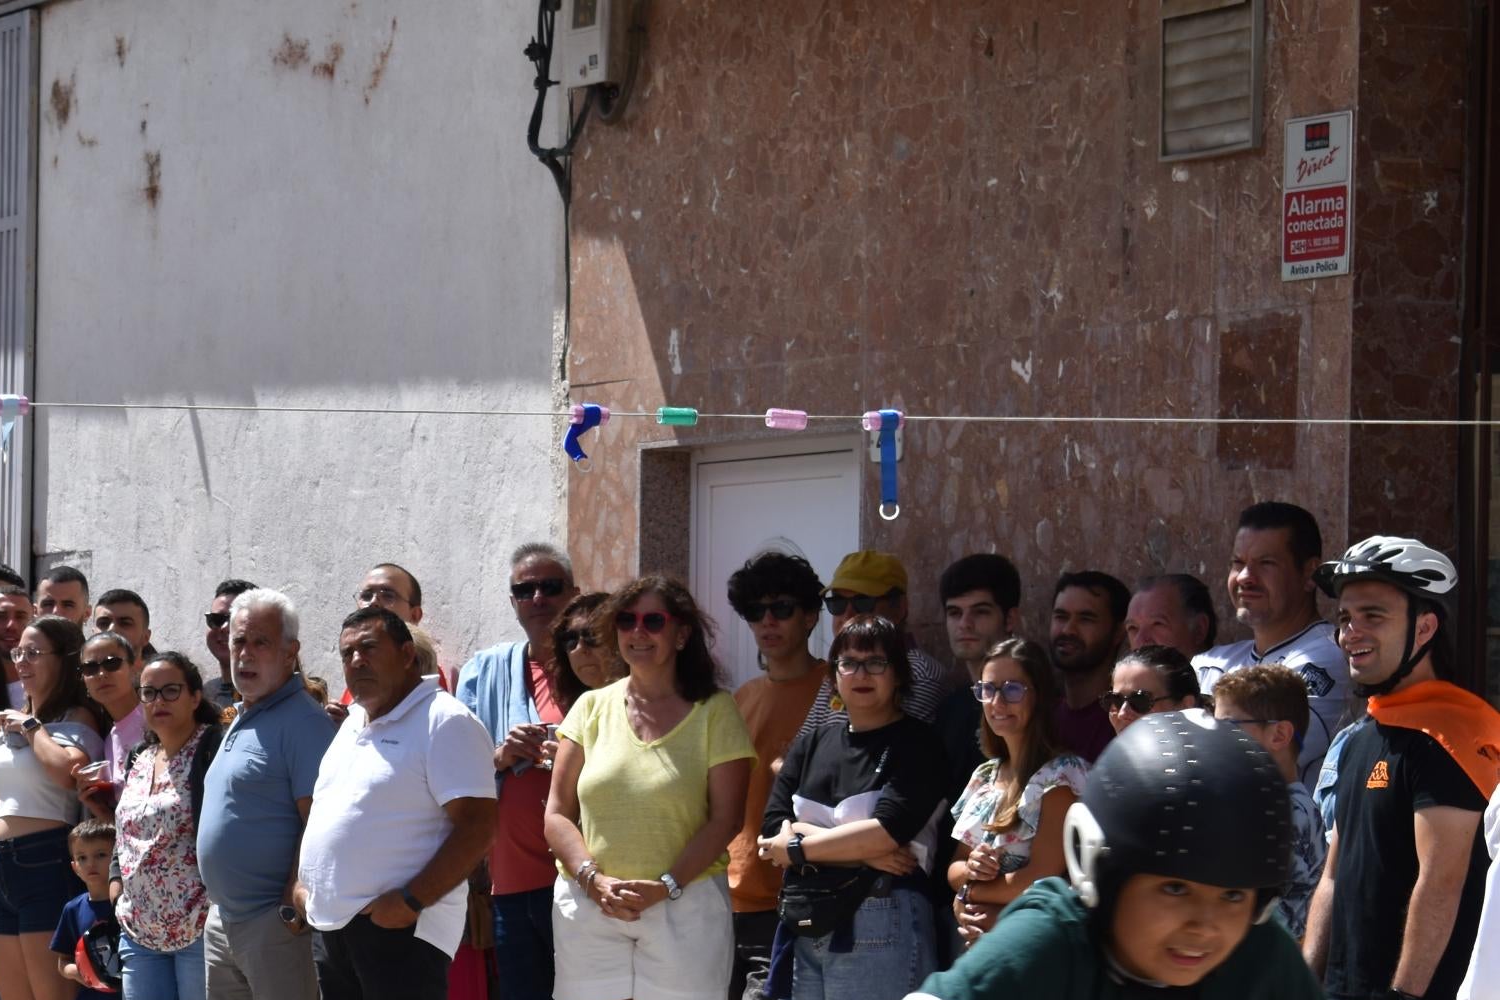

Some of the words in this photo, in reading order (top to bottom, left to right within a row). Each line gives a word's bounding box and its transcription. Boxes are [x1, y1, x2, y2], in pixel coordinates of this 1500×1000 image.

[1288, 194, 1344, 216] Alarma
[1287, 212, 1344, 233] conectada
[1290, 264, 1310, 276] Aviso
